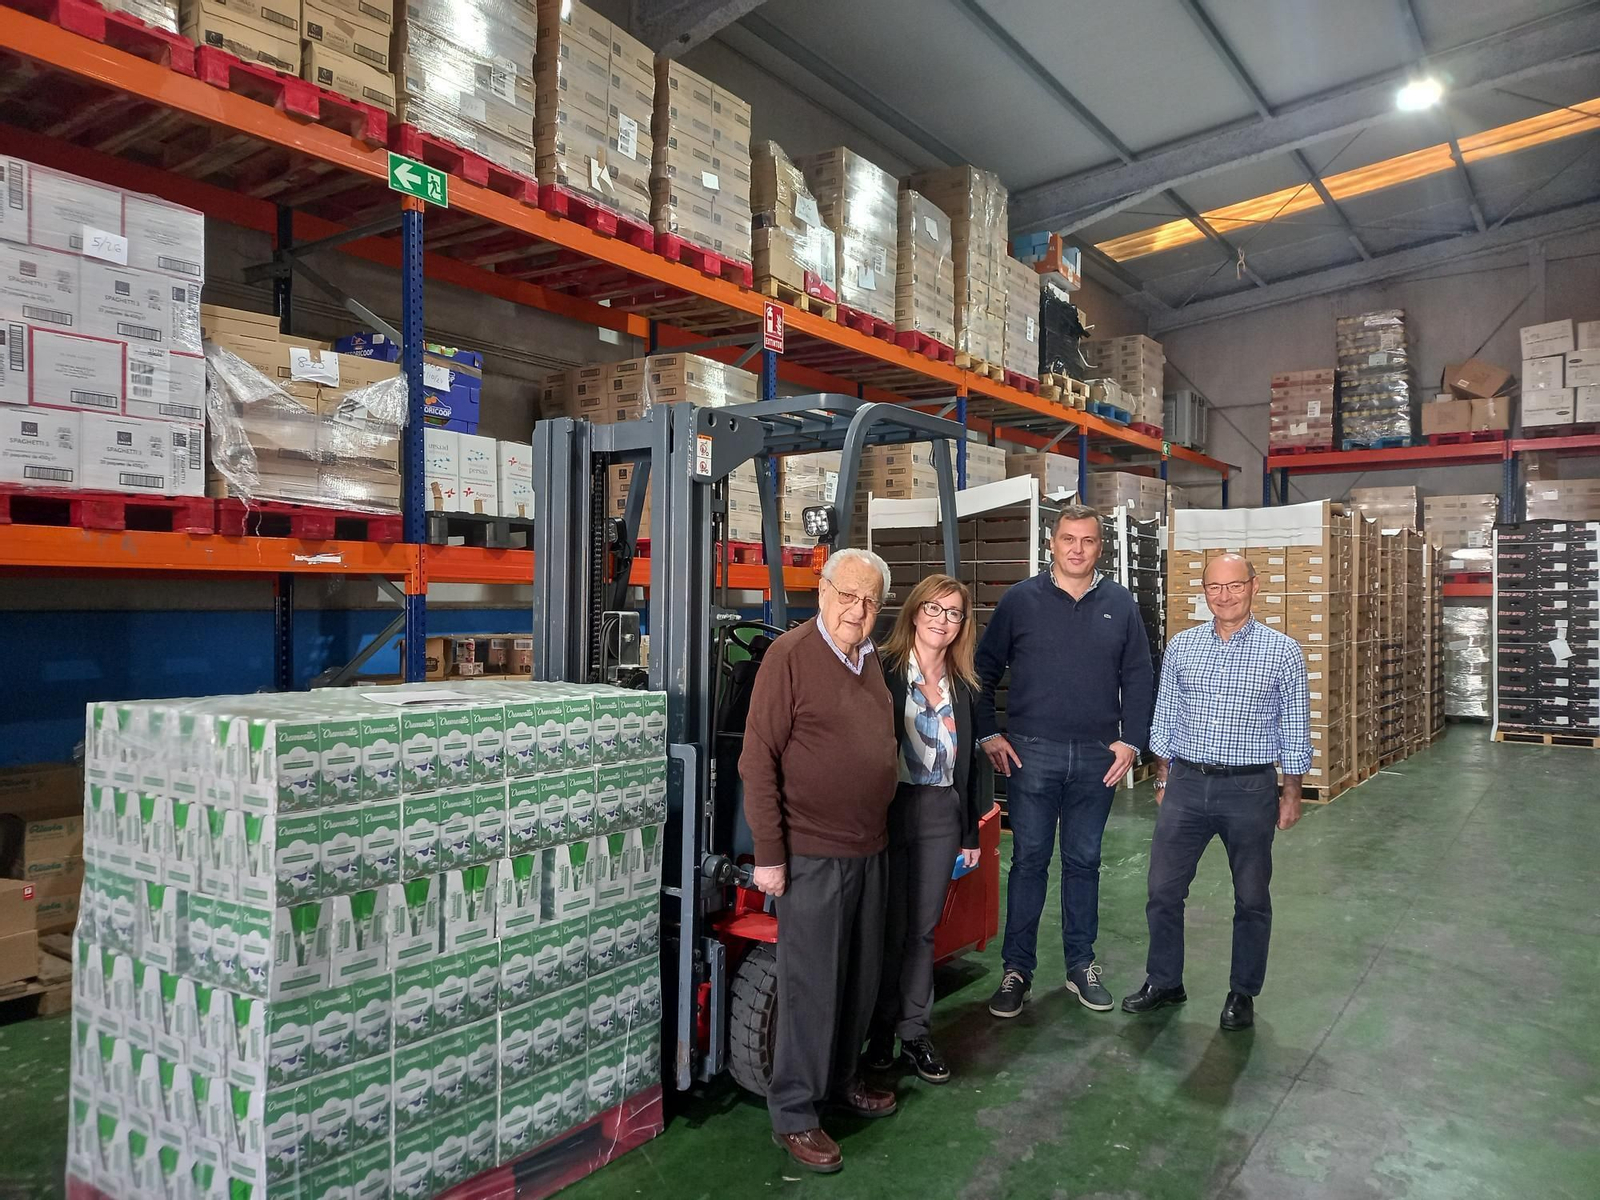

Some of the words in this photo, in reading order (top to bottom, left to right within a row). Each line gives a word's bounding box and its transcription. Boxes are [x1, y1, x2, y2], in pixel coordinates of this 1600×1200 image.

[104, 295, 137, 306] SPAGHETTI
[10, 437, 44, 446] SPAGHETTI
[106, 446, 137, 455] SPAGHETTI
